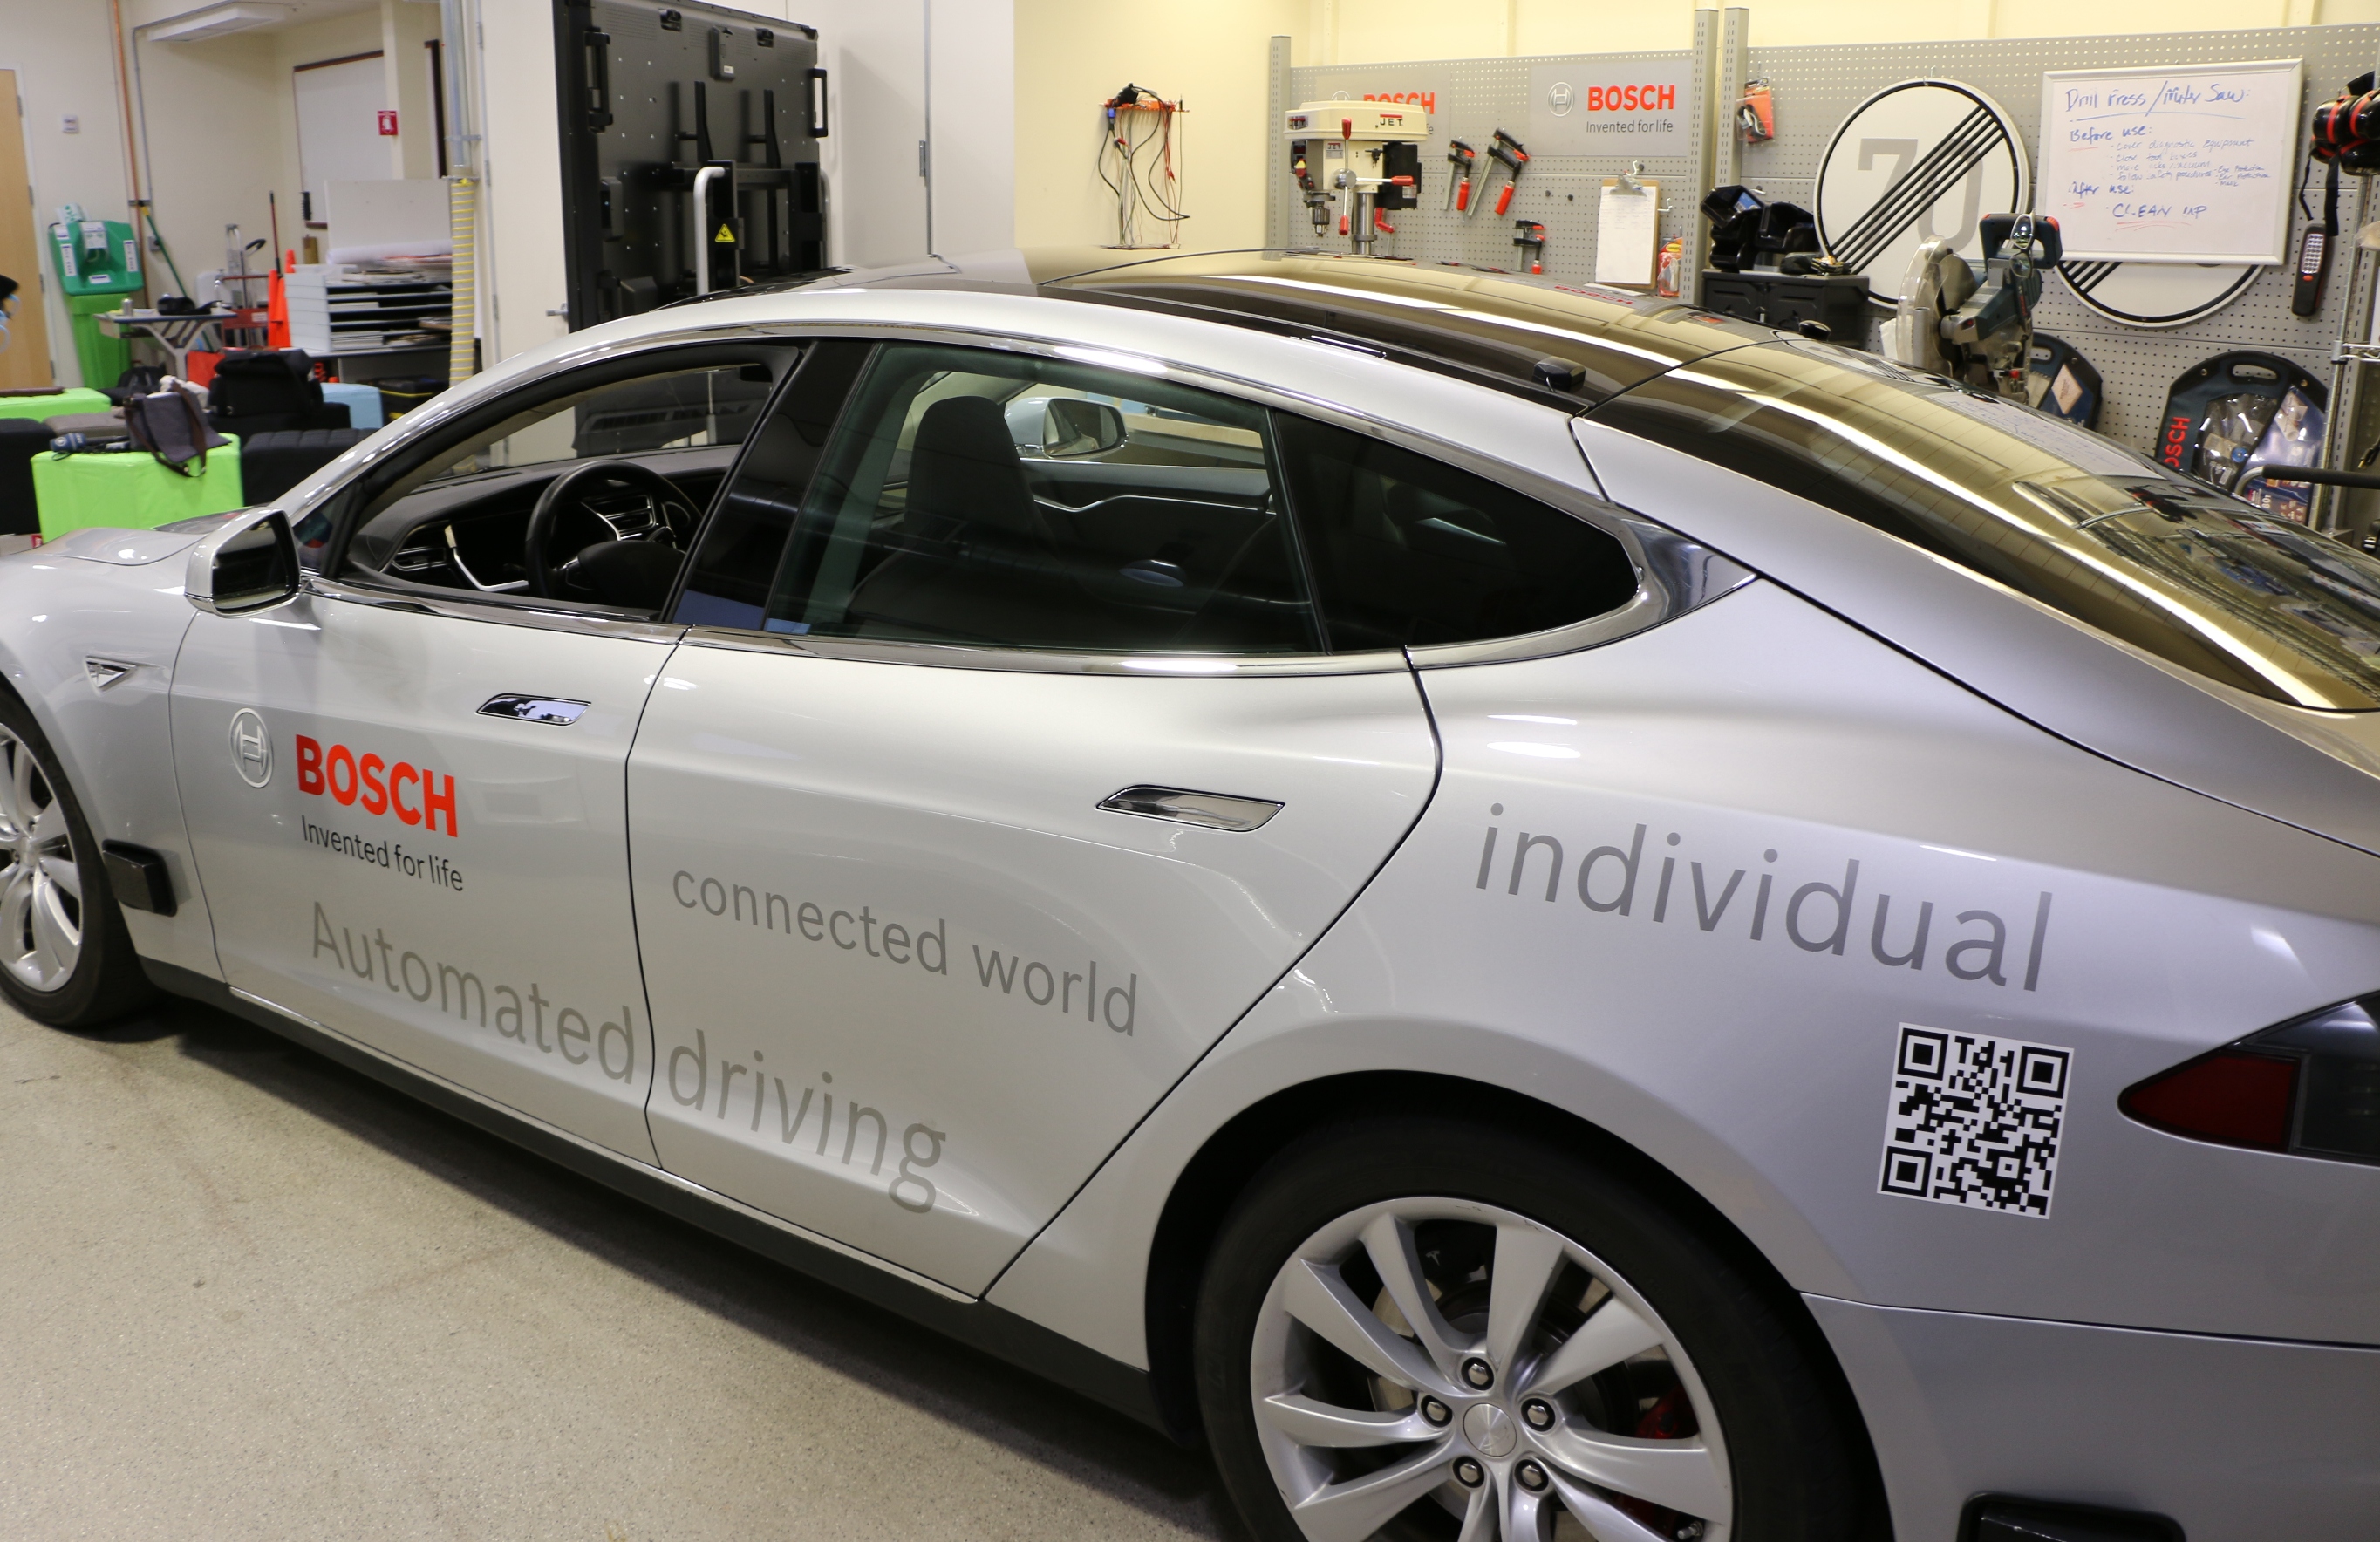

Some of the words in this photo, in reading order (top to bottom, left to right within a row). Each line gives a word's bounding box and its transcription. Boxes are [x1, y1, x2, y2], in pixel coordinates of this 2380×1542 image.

[1380, 117, 1403, 126] JET
[1586, 120, 1635, 133] Invented
[1638, 119, 1654, 132] for
[1656, 119, 1674, 132] life
[1587, 85, 1675, 111] BOSCH
[2070, 126, 2112, 144] Before
[1858, 138, 1983, 253] 70
[296, 734, 458, 837] BOSCH
[302, 815, 390, 869] Invented
[394, 844, 425, 879] for
[428, 854, 463, 891] life
[1476, 802, 2053, 993] individual
[672, 870, 948, 976] connected
[972, 944, 1137, 1036] world
[313, 901, 635, 1085] Automated
[668, 1028, 946, 1214] driving
